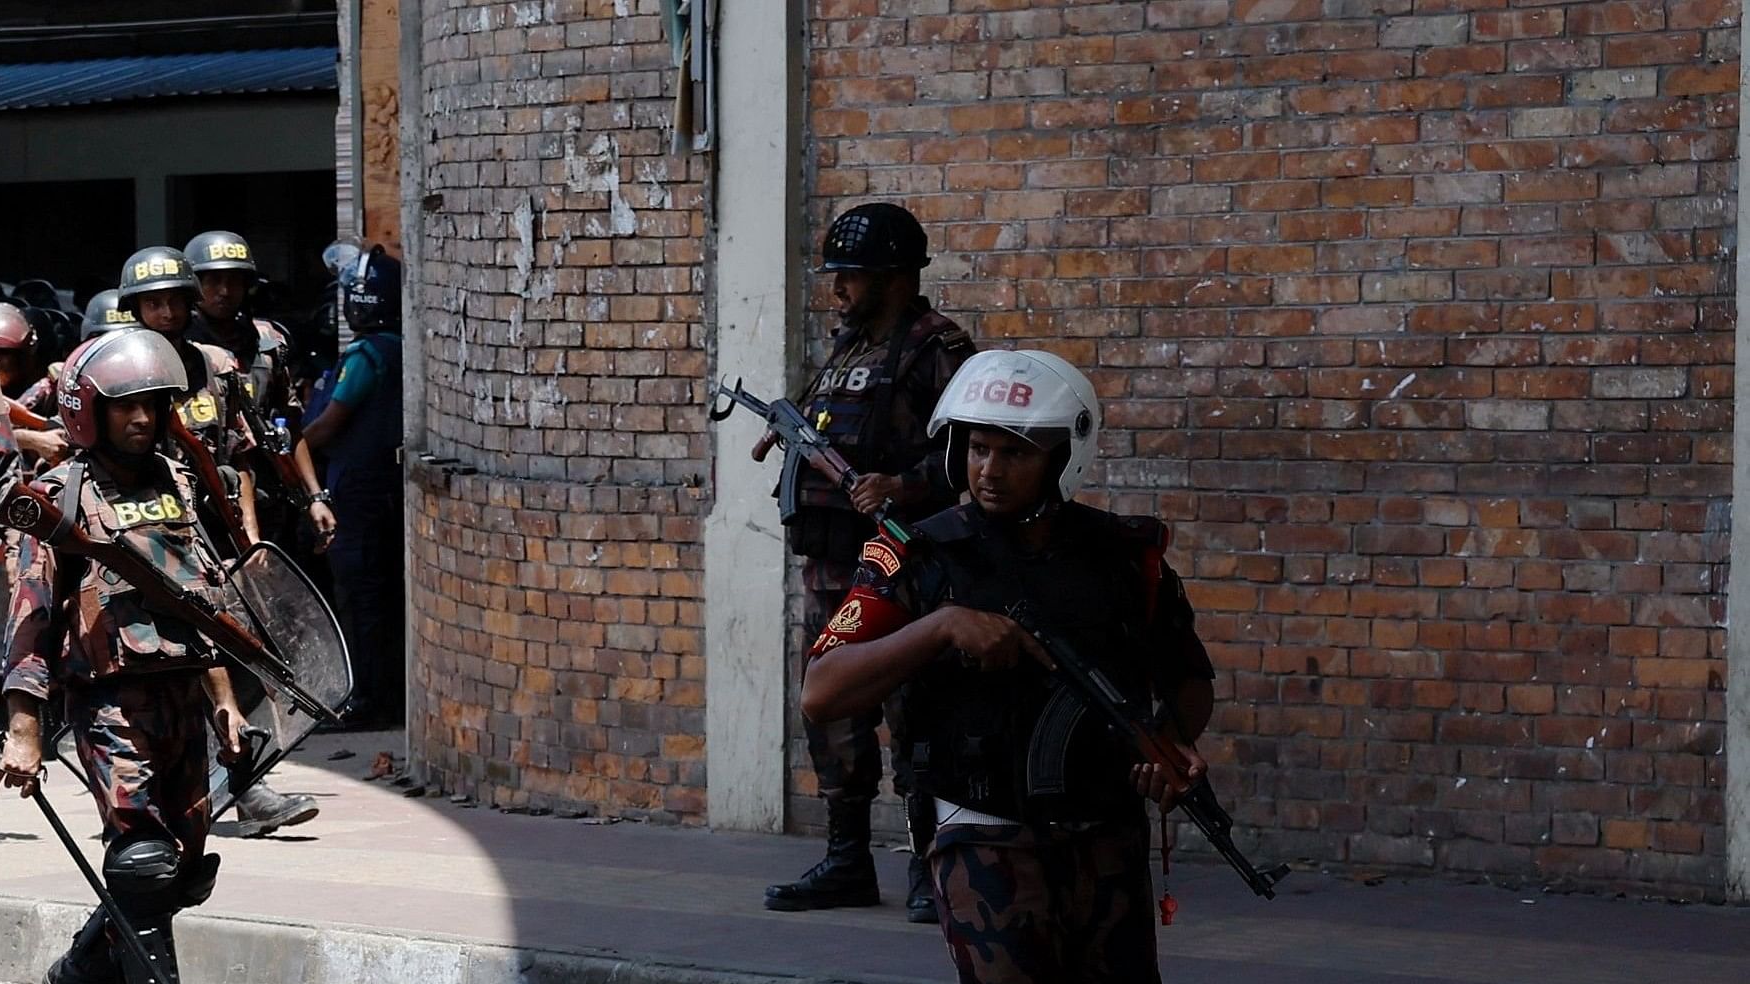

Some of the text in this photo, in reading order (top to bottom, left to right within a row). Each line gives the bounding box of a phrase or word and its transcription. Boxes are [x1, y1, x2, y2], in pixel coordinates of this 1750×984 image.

[209, 244, 247, 260] BGB
[135, 259, 179, 280] BGB
[350, 294, 378, 303] POLICE
[817, 367, 871, 391] BGB
[58, 390, 82, 410] BGB
[962, 379, 1034, 407] BGB
[113, 493, 181, 527] BGB
